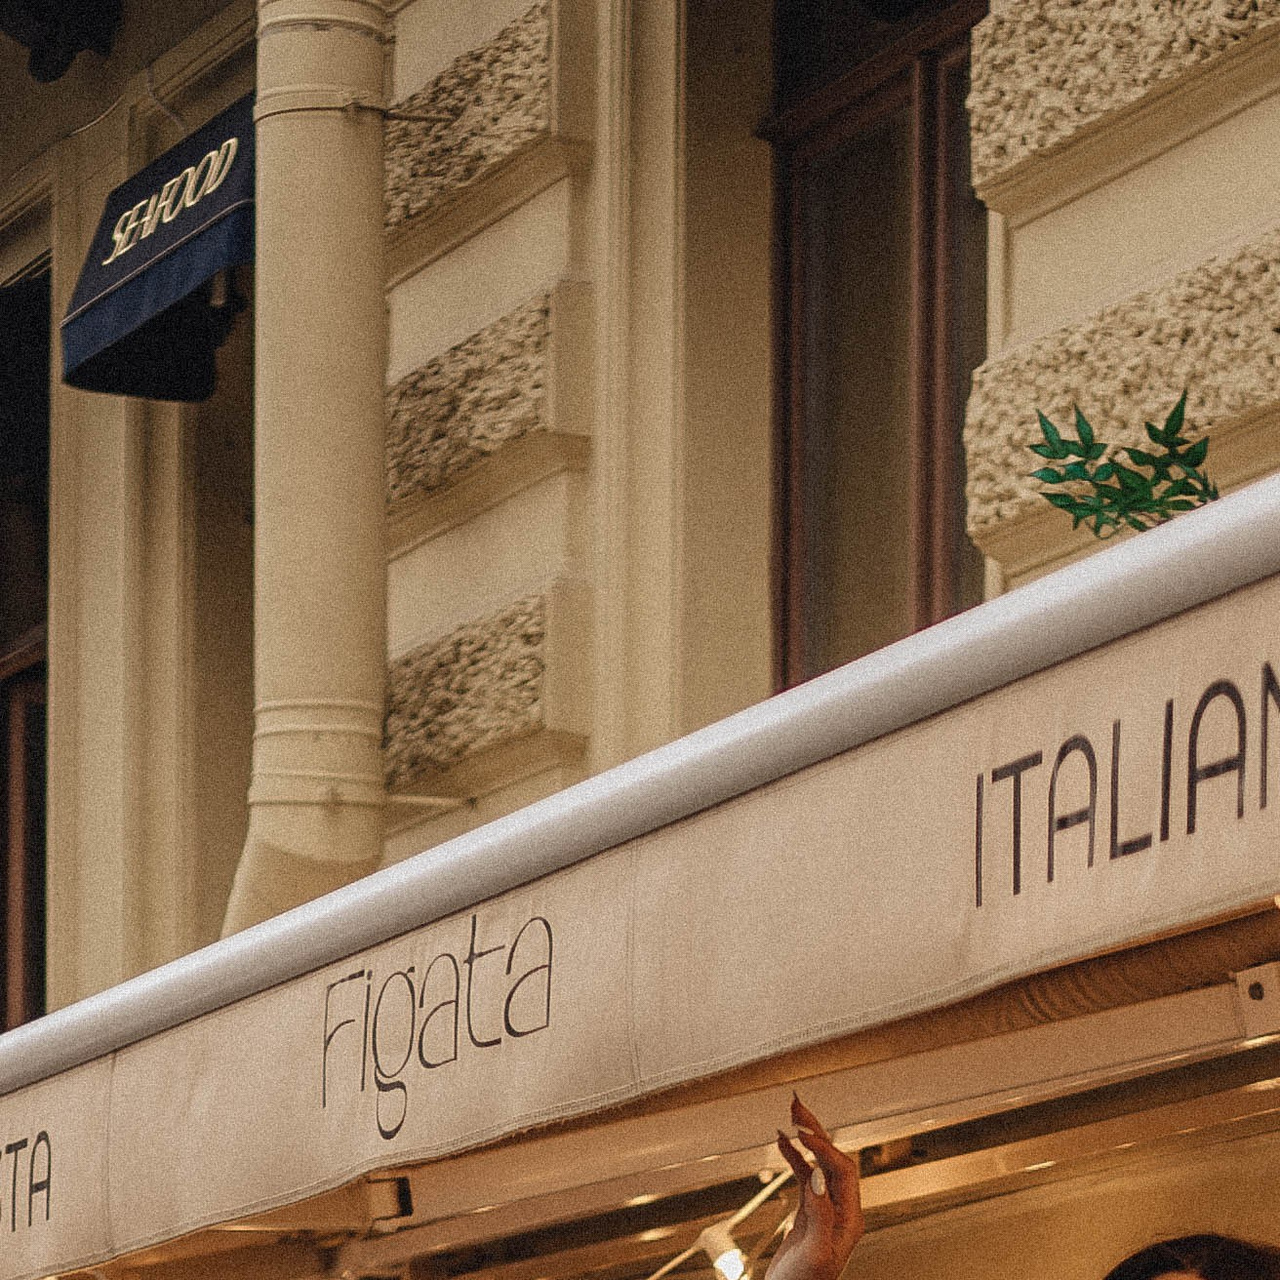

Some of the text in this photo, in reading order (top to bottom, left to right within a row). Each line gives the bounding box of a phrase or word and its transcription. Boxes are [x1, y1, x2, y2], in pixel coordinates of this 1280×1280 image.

[101, 137, 239, 266] SEAFOOD
[321, 914, 554, 1139] Figata
[0, 1130, 52, 1232] TA
